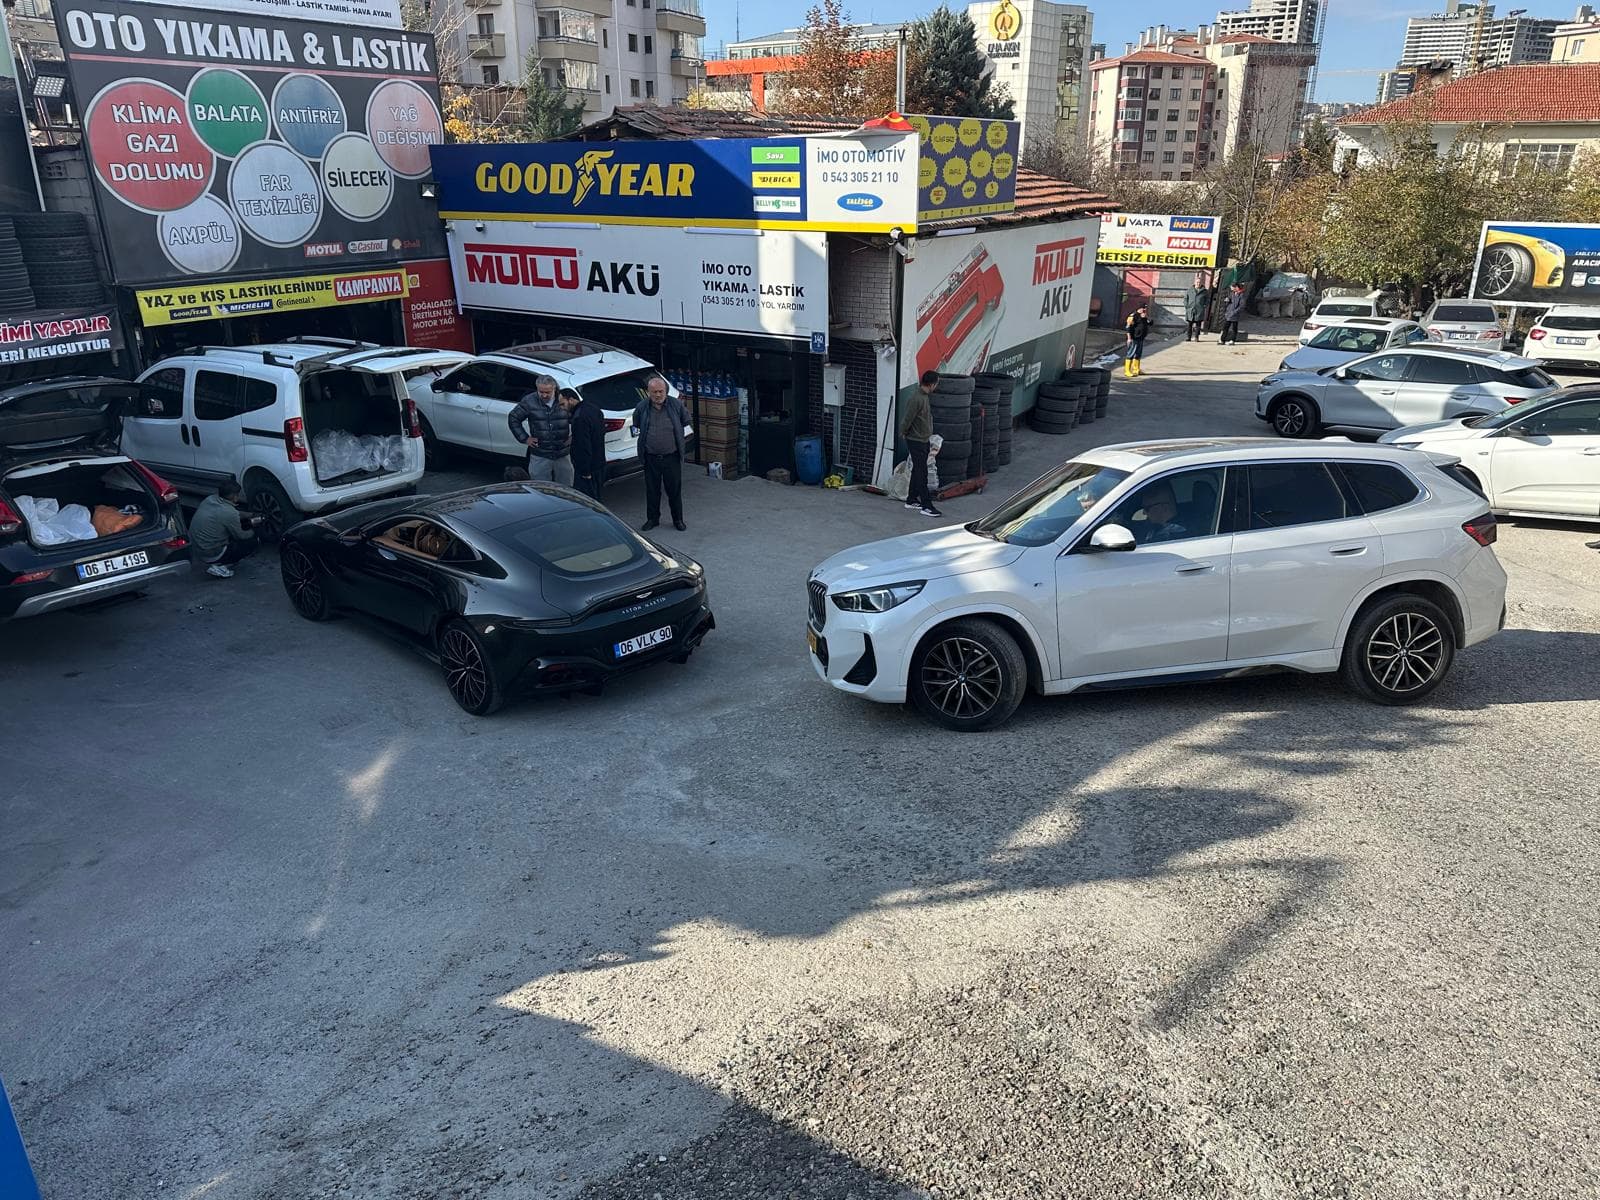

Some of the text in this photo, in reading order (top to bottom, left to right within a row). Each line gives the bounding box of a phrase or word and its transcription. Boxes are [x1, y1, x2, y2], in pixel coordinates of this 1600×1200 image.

[352, 8, 371, 16] HAVA
[372, 10, 392, 18] AYARI
[65, 9, 431, 72] OTO YIKAMA & LASTİK
[111, 101, 182, 125] KLİMA
[193, 103, 263, 123] BALATA
[279, 107, 341, 124] ANTİFRİZ
[389, 104, 419, 121] YAĞ
[126, 133, 179, 153] GAZI
[376, 127, 437, 148] DEĞİŞİMİ
[766, 152, 785, 160] Sava
[817, 145, 906, 163] İMO OTOMOTİV
[109, 163, 205, 182] DOLUMU
[327, 168, 389, 188] SİLECEK
[822, 172, 899, 183] 0 543 305 21 10
[259, 175, 292, 191] FAR
[238, 194, 319, 217] TEMİZLİĞİ
[1129, 218, 1163, 227] VARTA
[1190, 220, 1209, 229] AKÜ
[169, 223, 233, 246] AMPÜL
[1169, 238, 1209, 249] MOTUL
[306, 244, 342, 256] MOTUL
[357, 241, 384, 251] Castrol
[464, 243, 660, 297] MUTLU AKÜ
[702, 261, 752, 276] İMO OTO
[1032, 236, 1085, 286] MUTLU
[144, 280, 332, 308] YAZ ve KIŞ LASTİKLERİNDE
[336, 276, 402, 298] KAMPANYA
[702, 280, 749, 293] YIKAMA
[759, 284, 805, 297] LASTİK
[229, 301, 270, 312] MICHELIN
[276, 296, 311, 308] Continental
[702, 295, 720, 304] 0543
[721, 297, 735, 306] 305
[736, 297, 745, 306] 21
[747, 299, 756, 308] 10
[761, 301, 776, 309] YOL
[776, 302, 805, 311] YARDIM
[1039, 284, 1073, 319] AKÜ
[443, 307, 454, 316] İLK
[34, 315, 111, 339] YAPILIR
[412, 315, 456, 329] MOTOR YAĞI
[0, 339, 111, 362] ERİ MEVCUTTUR
[85, 553, 146, 576] 06 FL 4195
[621, 596, 666, 614] ASTON MARTIN
[620, 627, 672, 654] 06 VLK 90
